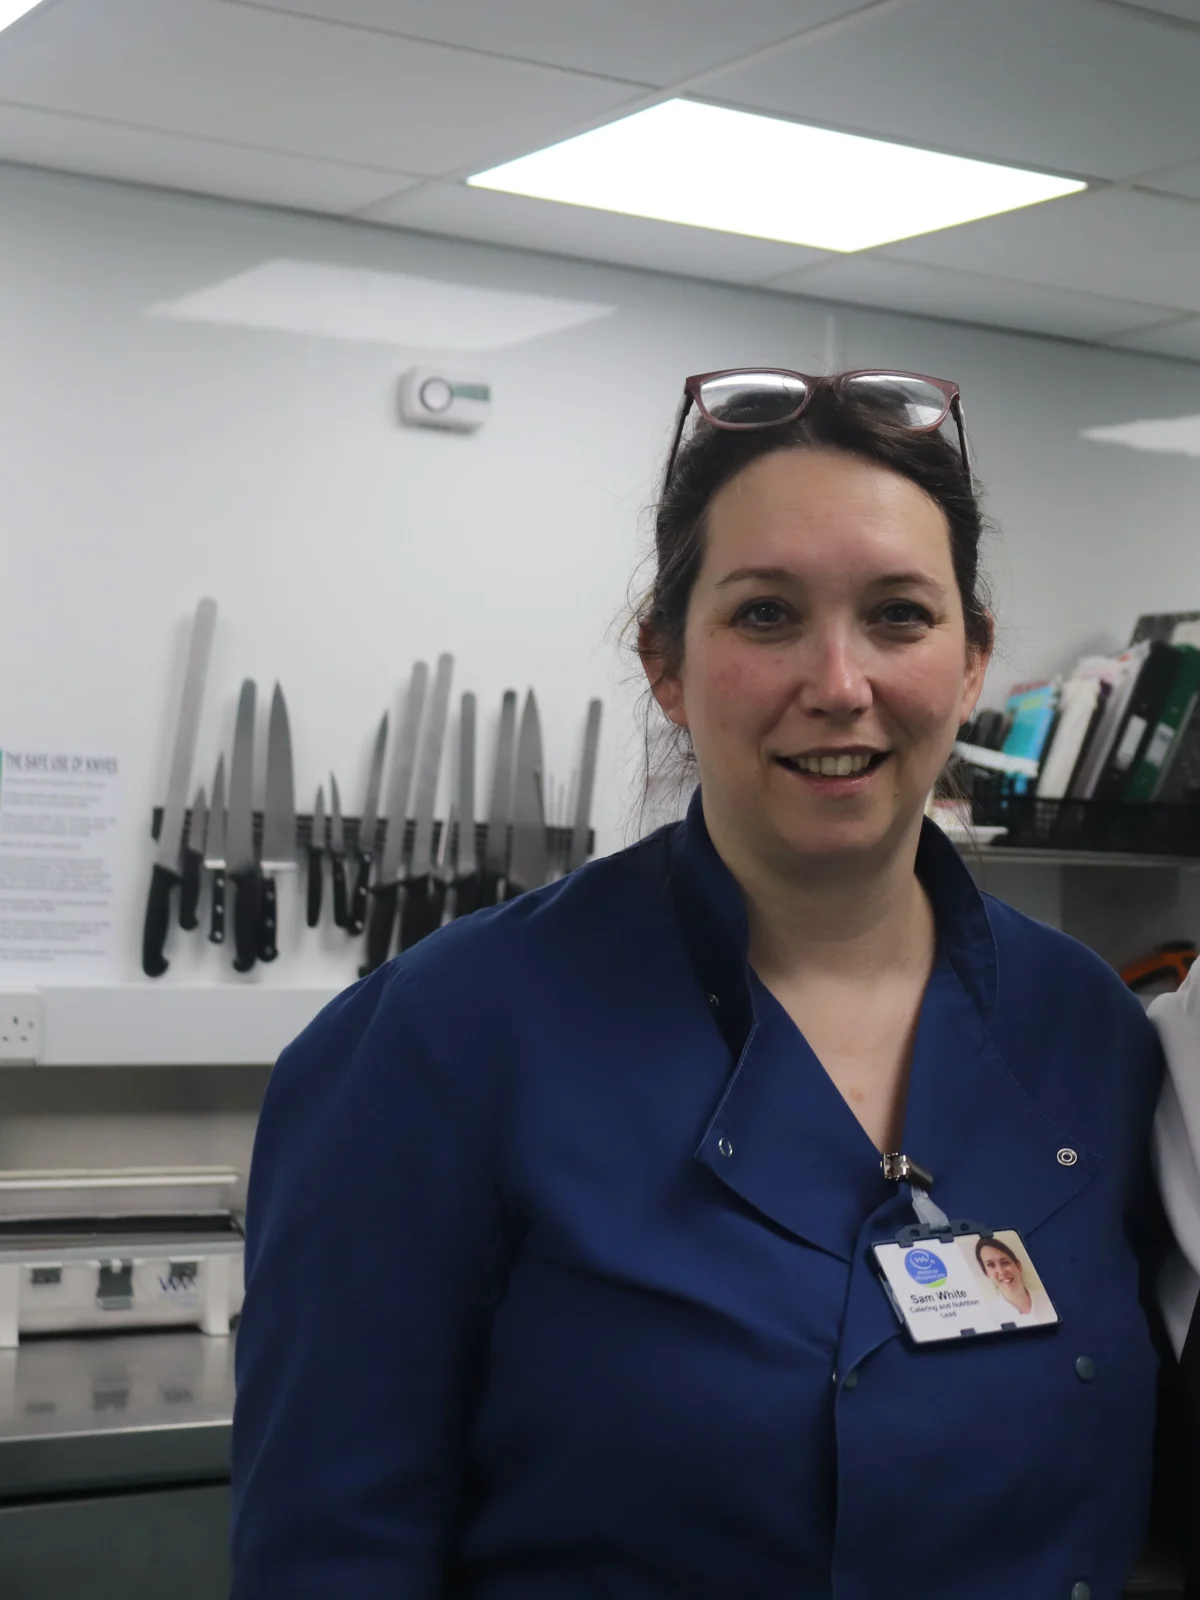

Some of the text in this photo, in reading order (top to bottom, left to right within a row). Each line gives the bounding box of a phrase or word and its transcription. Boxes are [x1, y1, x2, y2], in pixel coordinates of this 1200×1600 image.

[5, 752, 21, 770] THE
[25, 752, 48, 772] SAFE
[910, 1289, 967, 1304] Sam White
[909, 1305, 939, 1313] Catering
[952, 1299, 980, 1307] Nutrition
[940, 1310, 957, 1318] Lead
